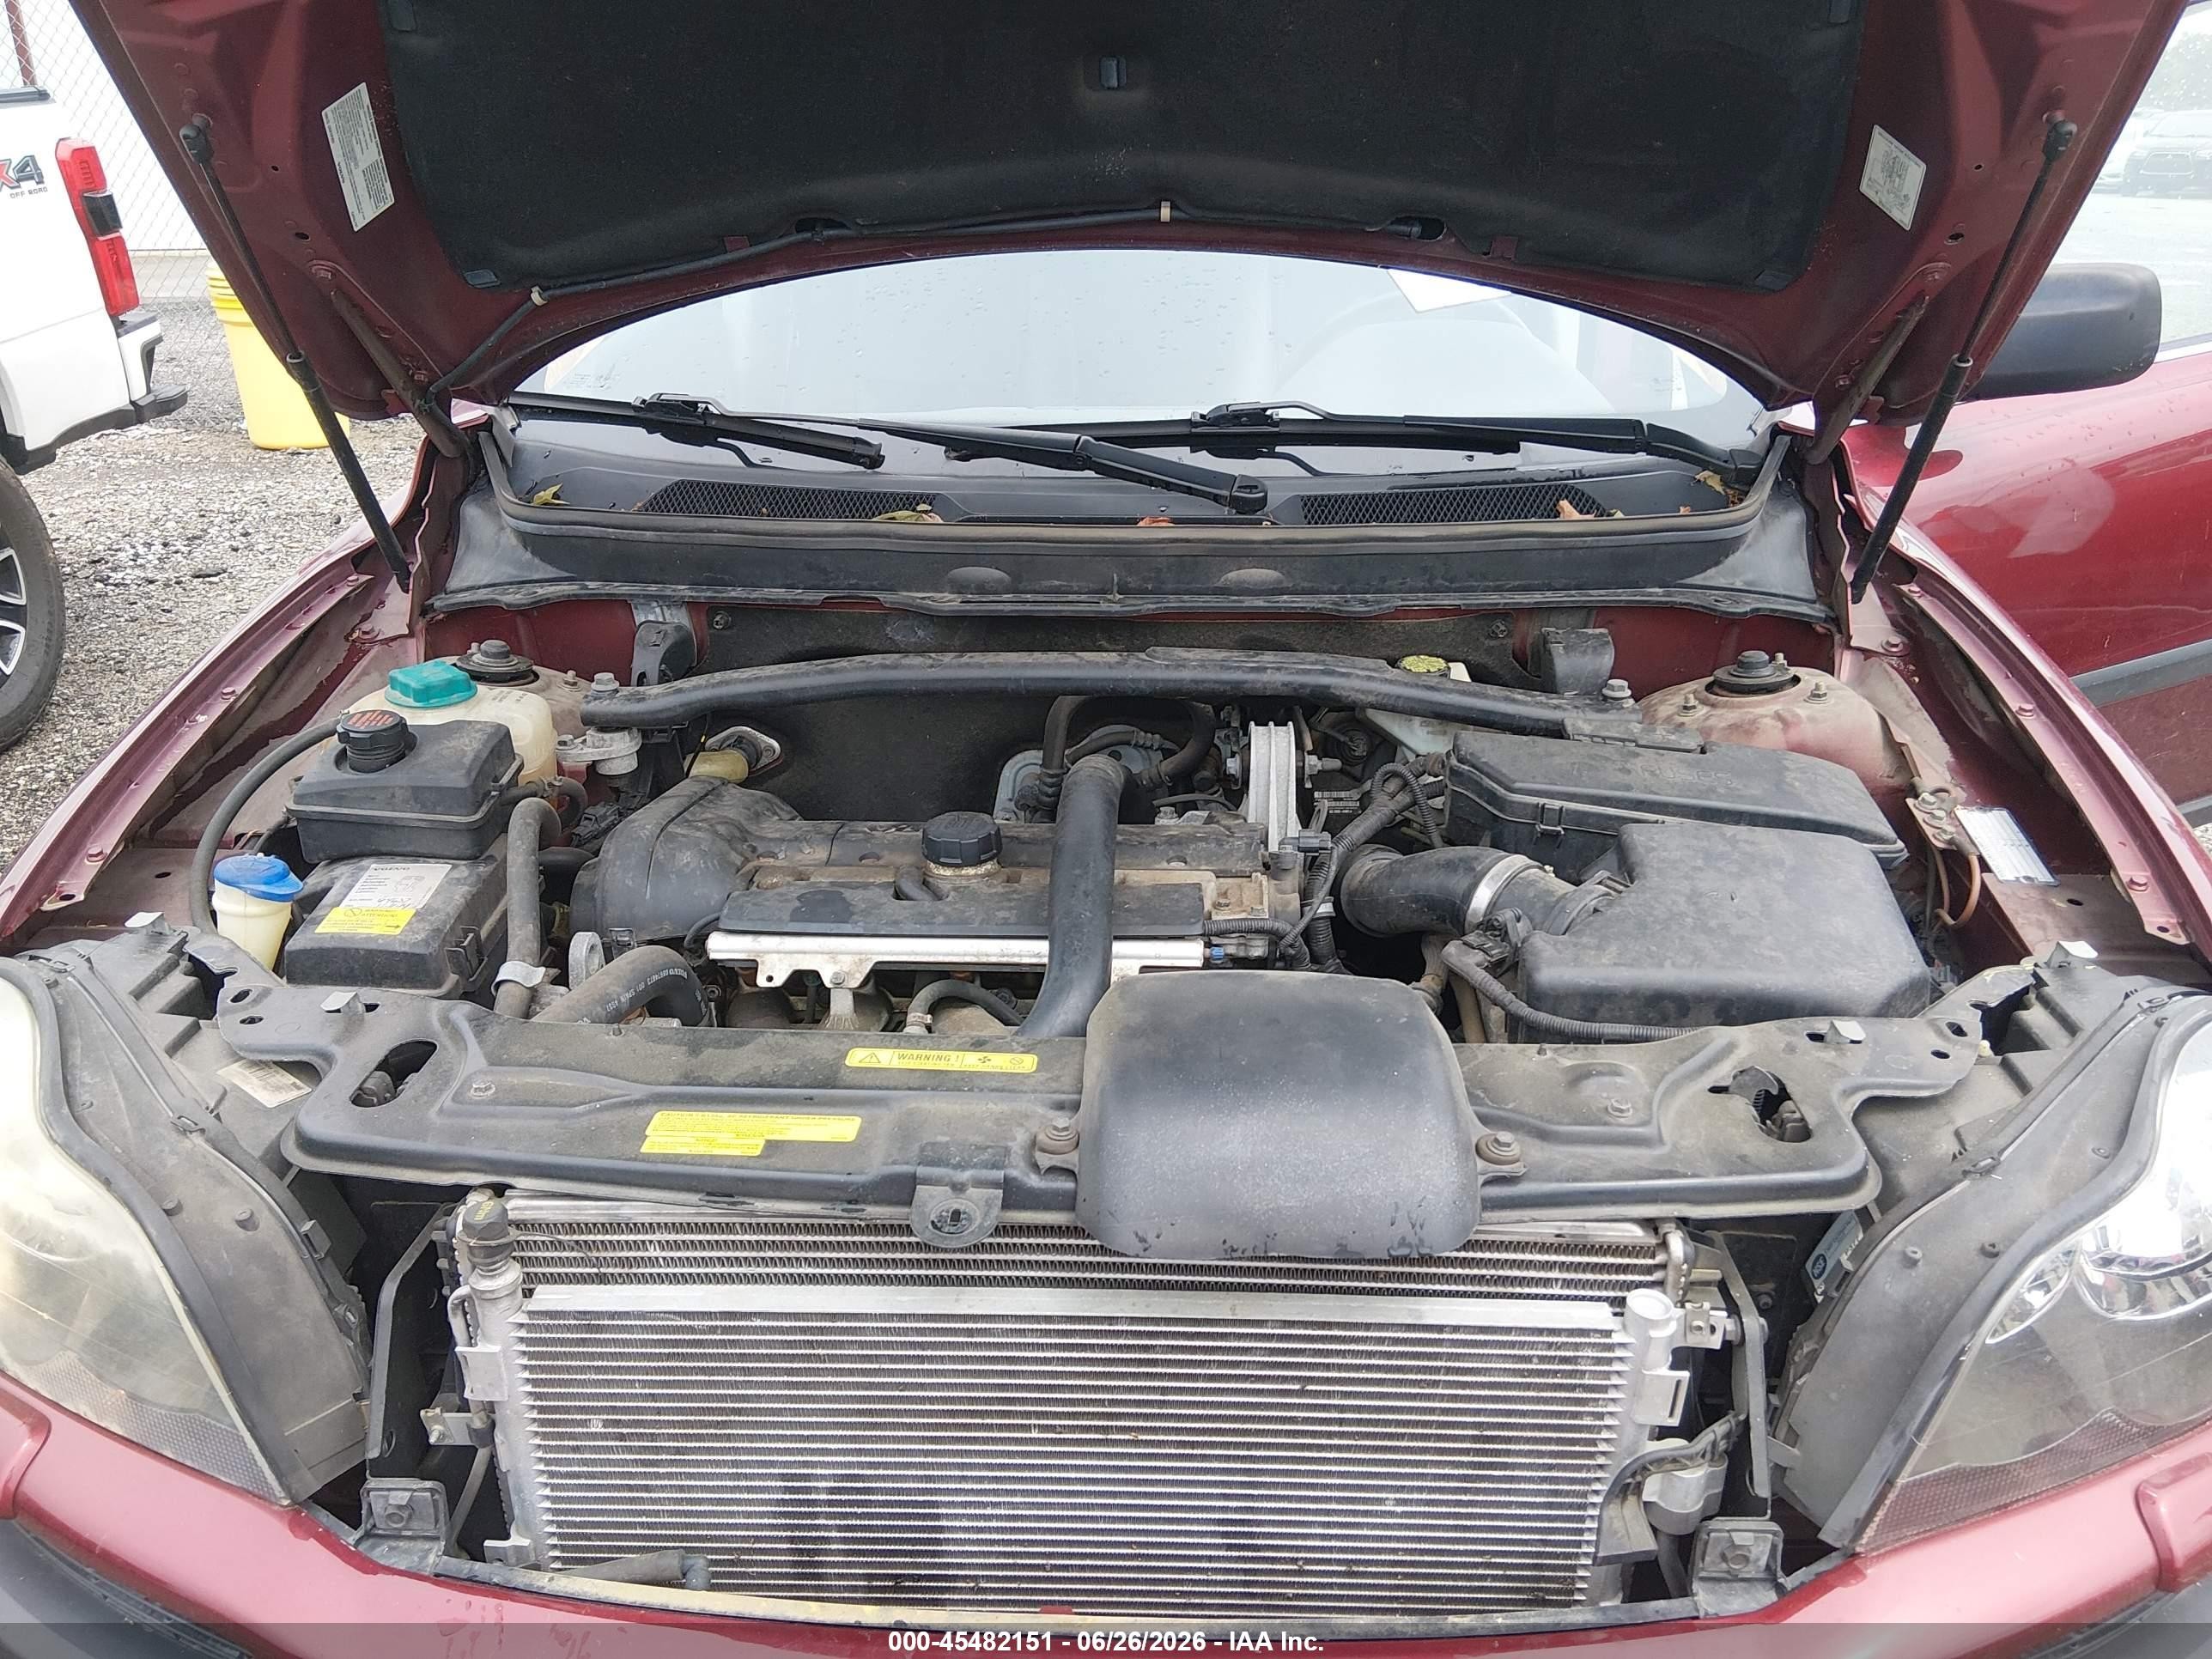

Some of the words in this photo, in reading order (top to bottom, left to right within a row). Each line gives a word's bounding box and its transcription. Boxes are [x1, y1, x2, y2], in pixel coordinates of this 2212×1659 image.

[9, 191, 26, 199] OFF
[27, 186, 48, 195] ROAD
[620, 989, 635, 1003] SPAIN
[897, 1053, 952, 1062] WARNING
